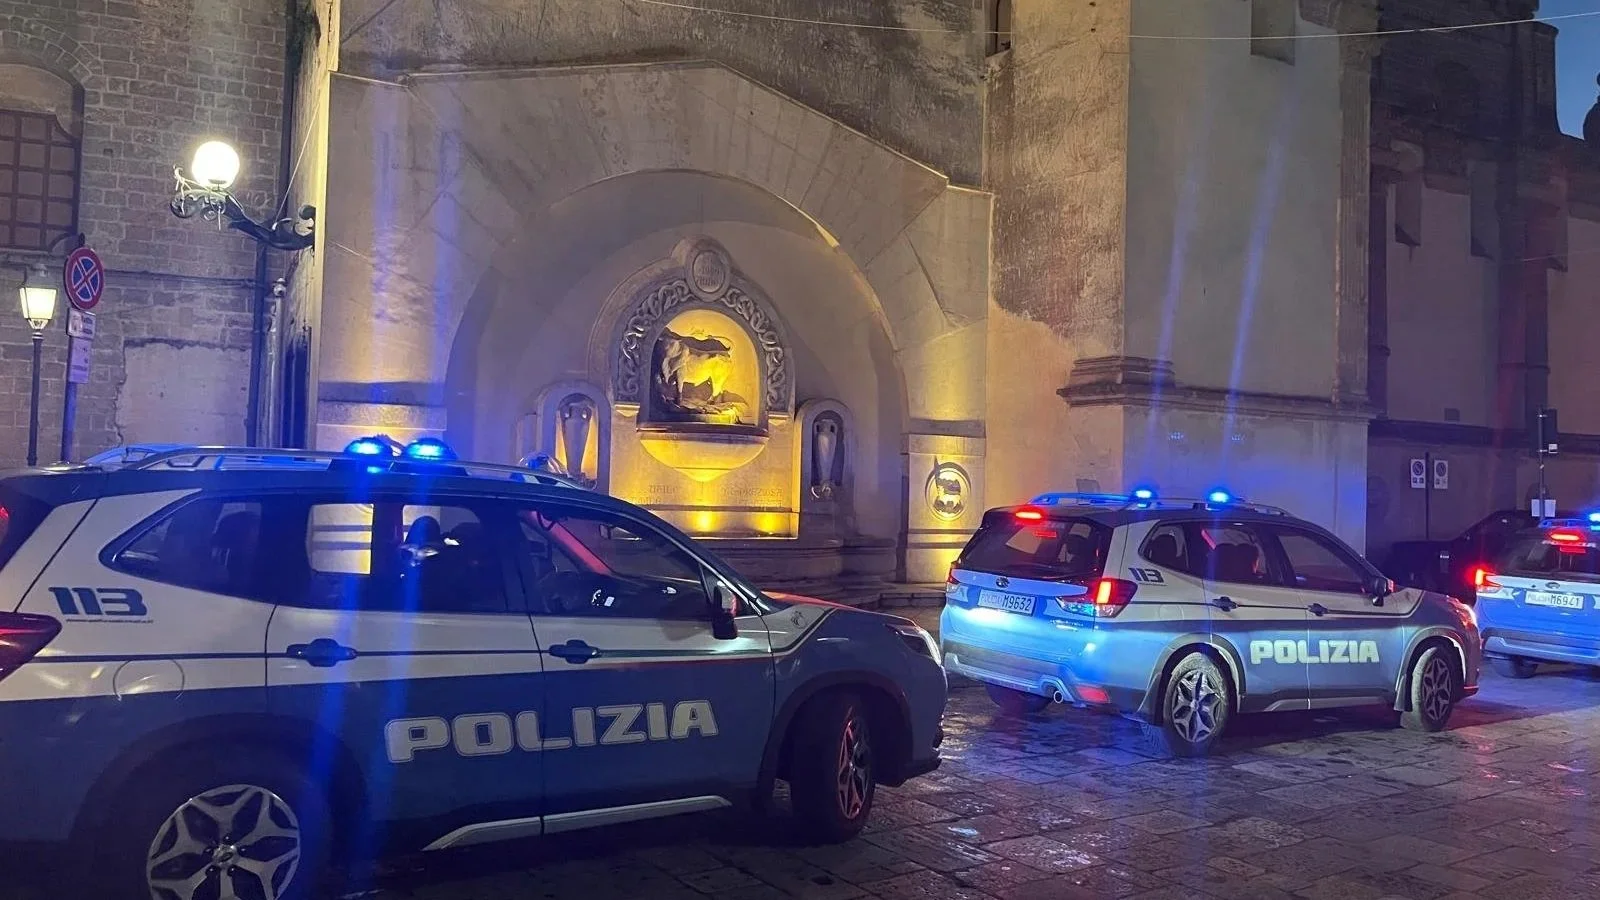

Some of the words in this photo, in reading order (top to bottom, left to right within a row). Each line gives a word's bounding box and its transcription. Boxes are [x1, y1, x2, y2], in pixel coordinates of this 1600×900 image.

[1128, 567, 1165, 583] 113
[47, 587, 148, 616] 113
[1002, 595, 1032, 611] M9632
[1250, 640, 1380, 665] POLIZIA
[384, 700, 719, 763] POLIZIA
